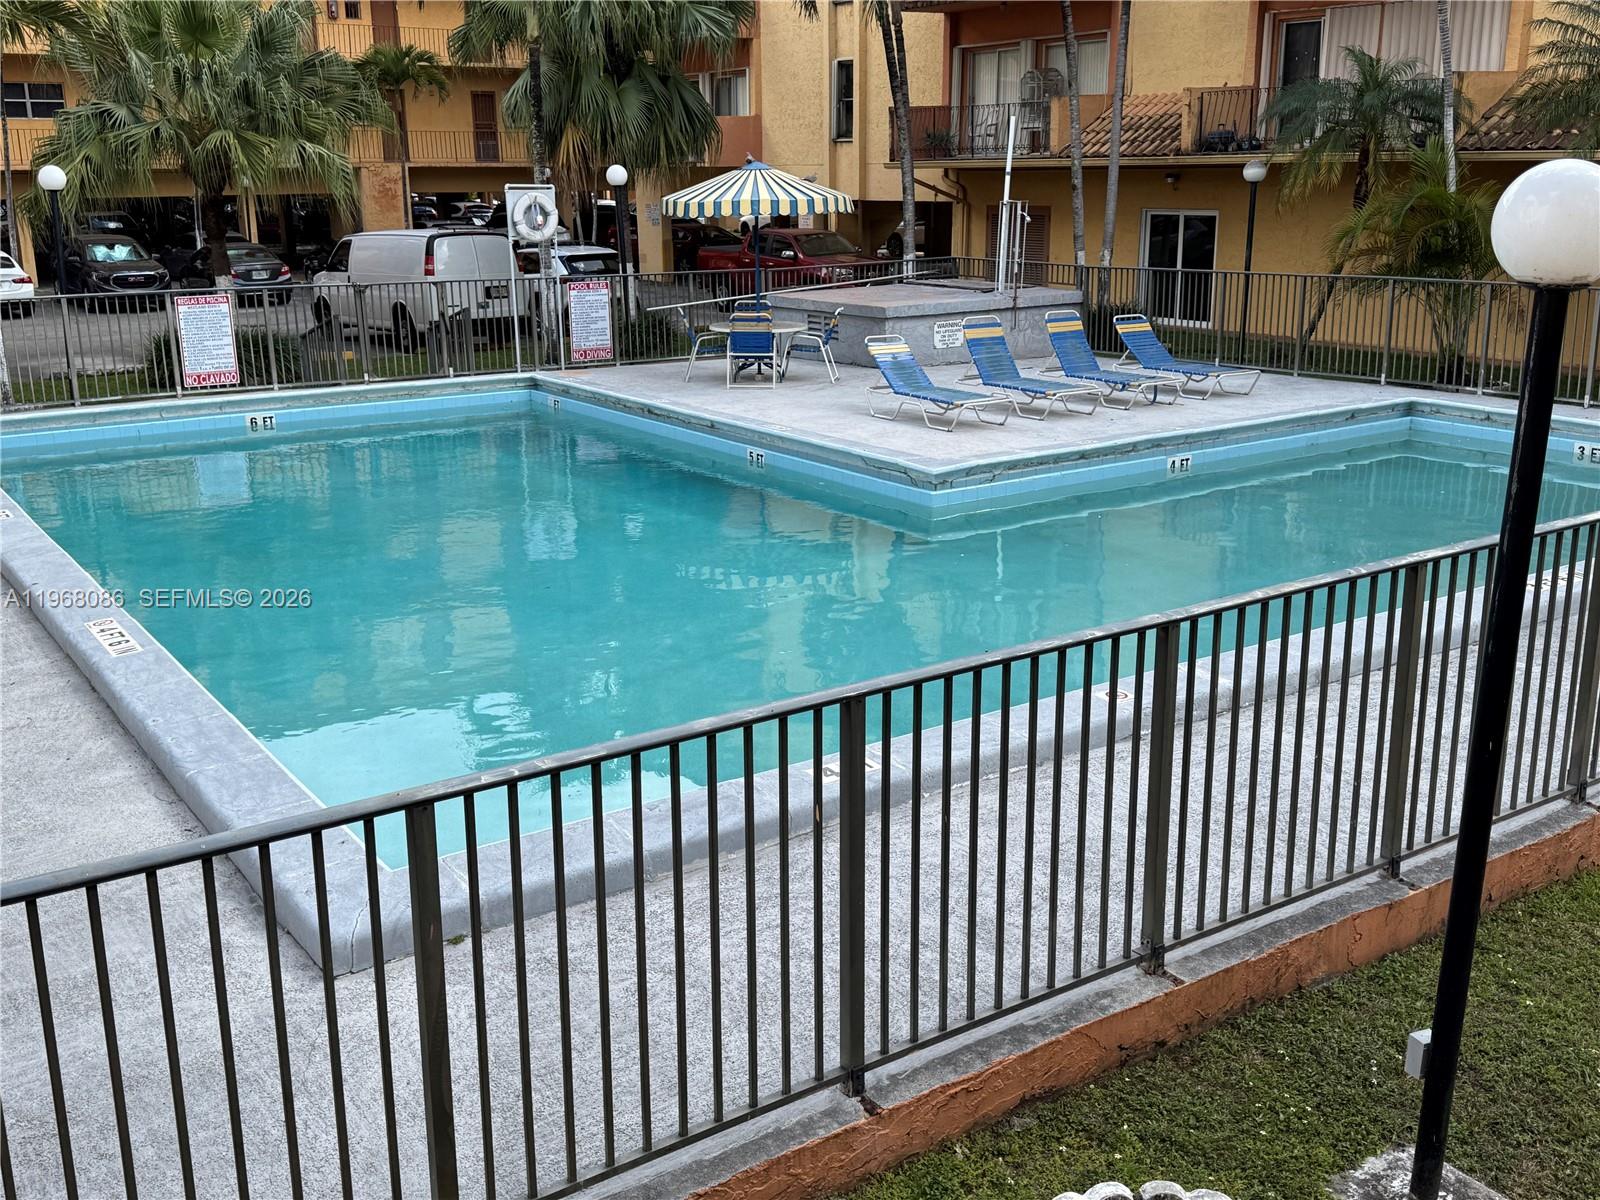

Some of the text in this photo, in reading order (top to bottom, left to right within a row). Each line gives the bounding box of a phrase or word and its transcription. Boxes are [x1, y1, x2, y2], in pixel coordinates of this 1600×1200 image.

[574, 350, 611, 360] NO DIVING
[186, 372, 237, 385] NO CLAVADO
[250, 415, 275, 428] 6 FT
[1578, 445, 1600, 459] 3 F
[756, 453, 764, 464] FT
[1180, 457, 1190, 469] FT
[99, 631, 126, 641] FT
[107, 639, 131, 647] 6
[112, 645, 139, 656] IN
